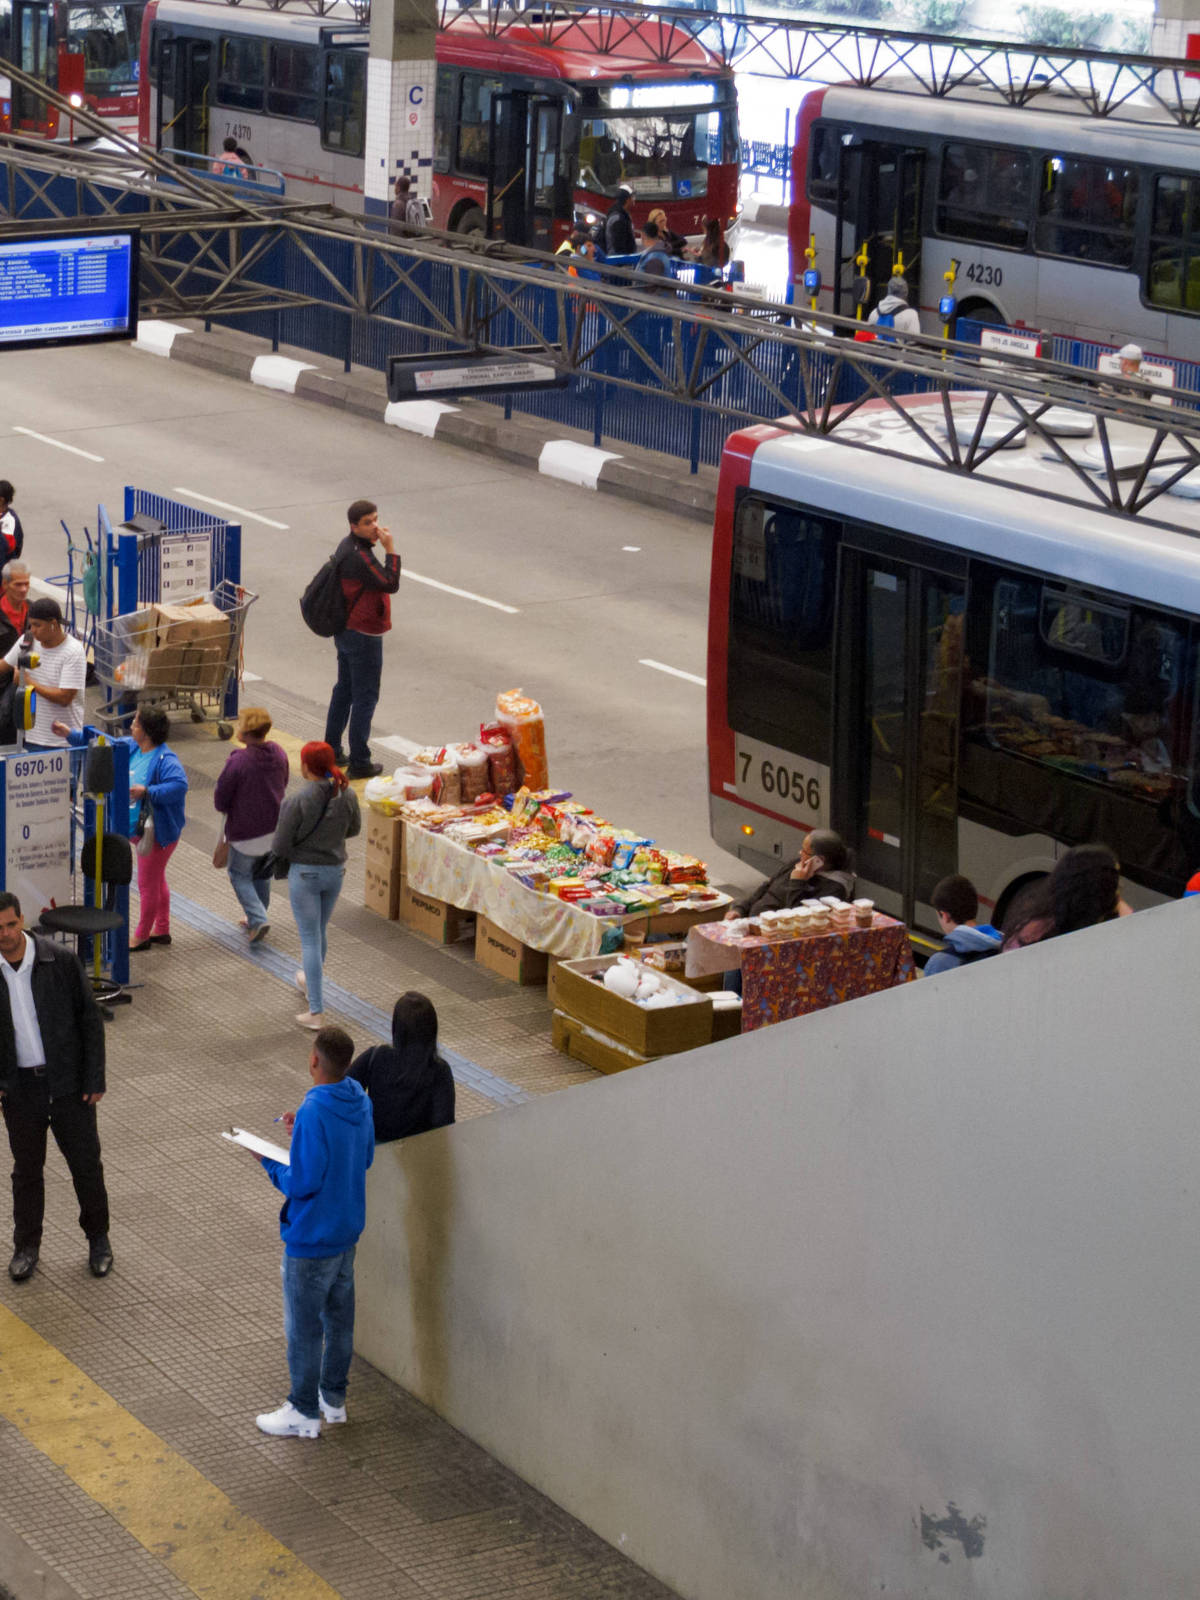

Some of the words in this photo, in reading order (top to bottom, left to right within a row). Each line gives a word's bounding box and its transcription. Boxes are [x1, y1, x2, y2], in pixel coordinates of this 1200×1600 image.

[409, 86, 424, 104] C
[225, 122, 231, 137] 7
[966, 267, 1003, 287] 4230
[15, 757, 63, 777] 6970-10
[739, 752, 752, 783] 7
[761, 760, 820, 810] 6056
[22, 825, 30, 840] 0
